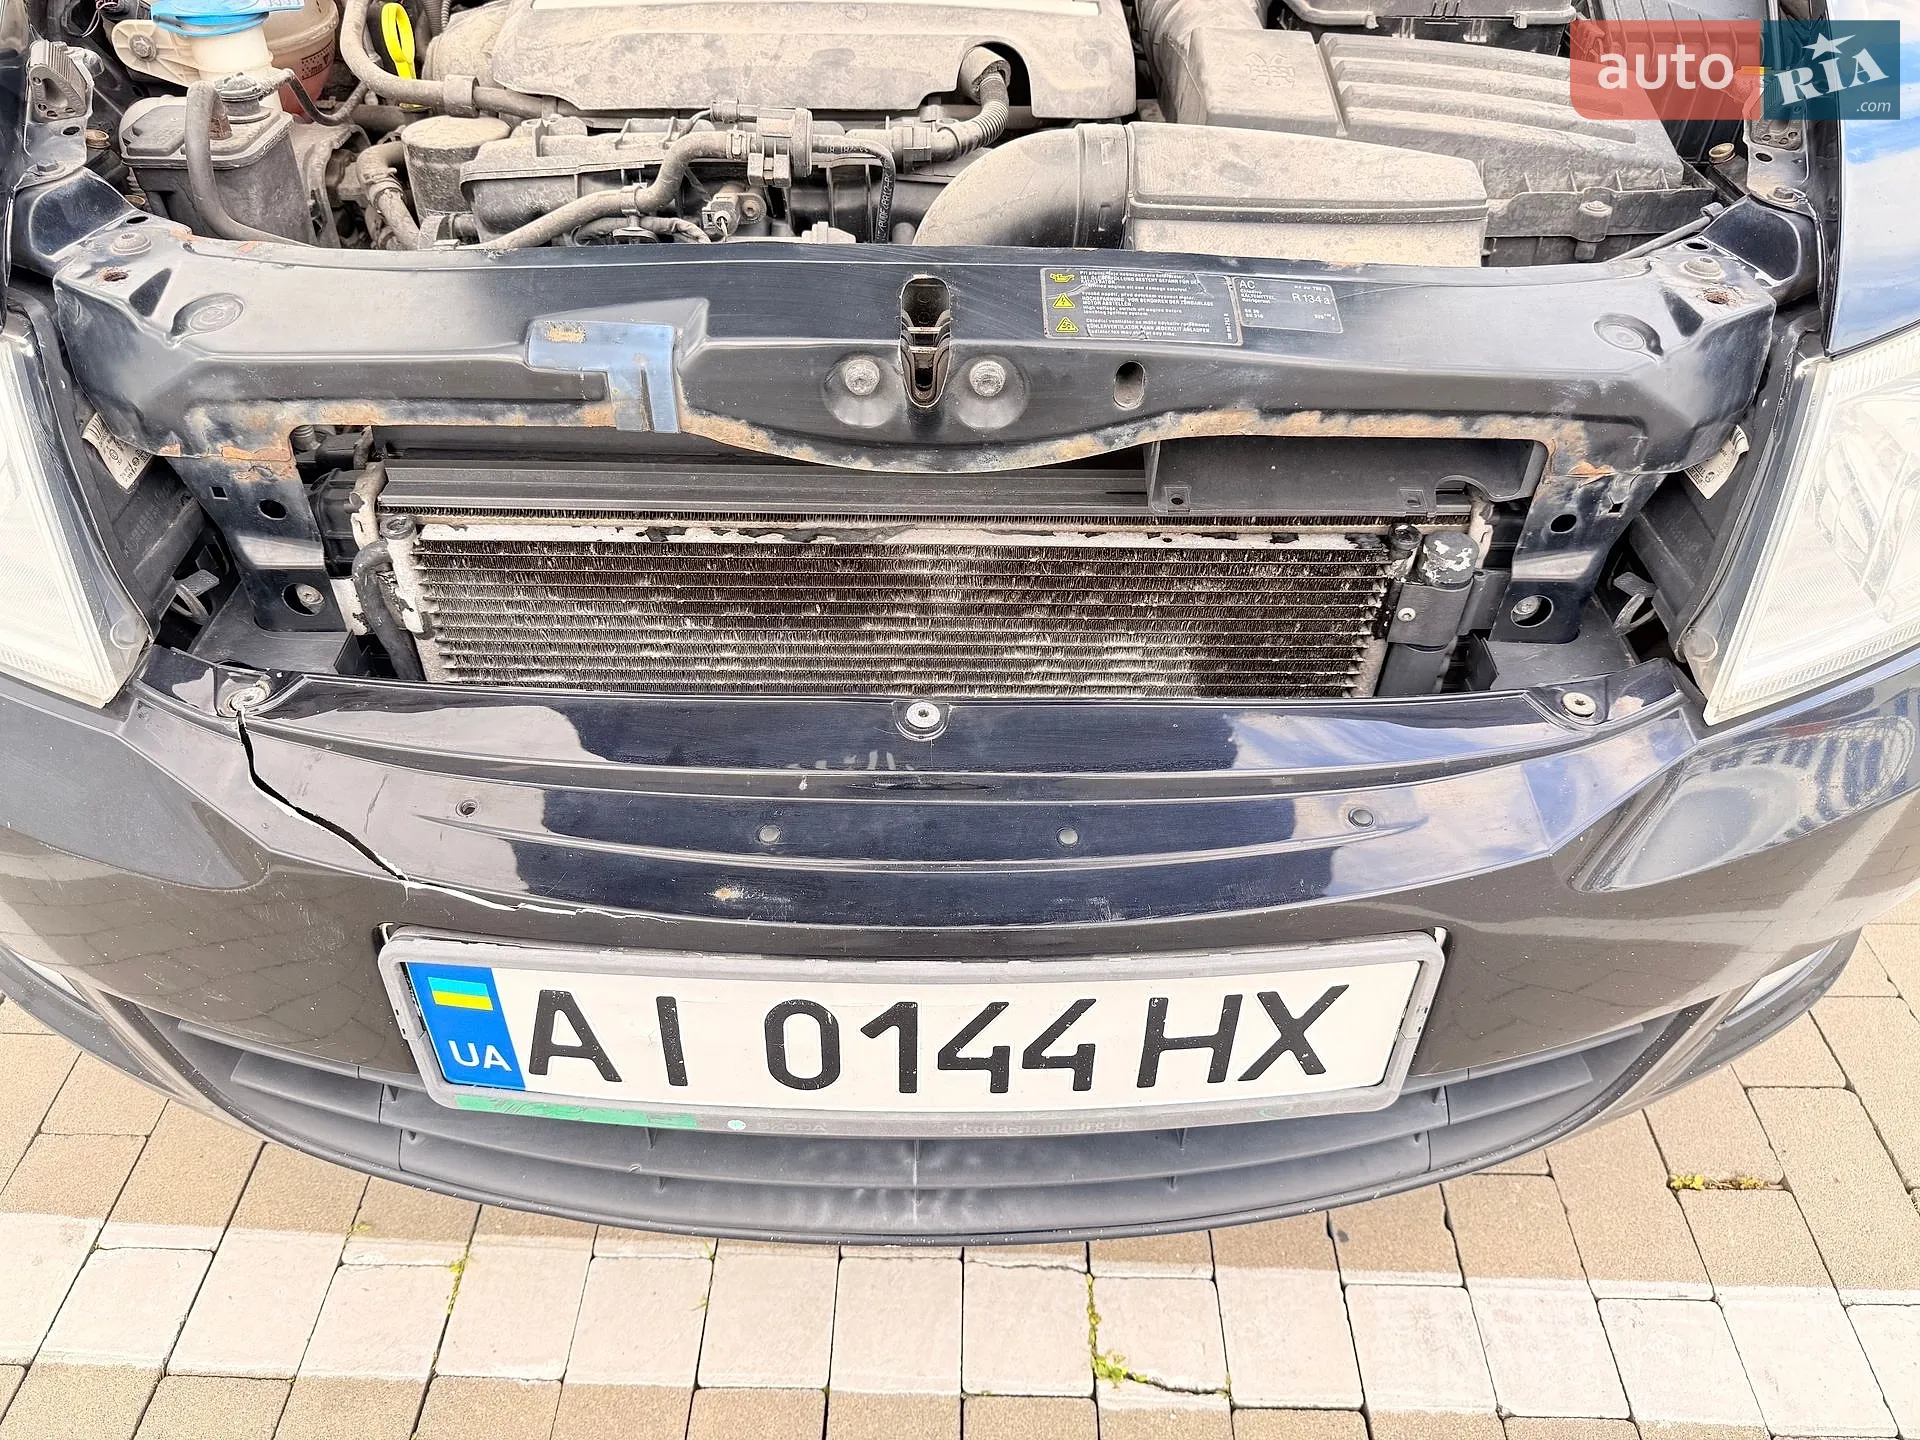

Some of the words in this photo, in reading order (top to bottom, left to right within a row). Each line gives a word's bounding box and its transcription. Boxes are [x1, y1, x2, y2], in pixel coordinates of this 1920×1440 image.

[1240, 279, 1256, 290] AC
[449, 1039, 512, 1072] UA
[529, 989, 689, 1087] AI
[763, 998, 1097, 1094] 0144
[1137, 984, 1350, 1088] HX
